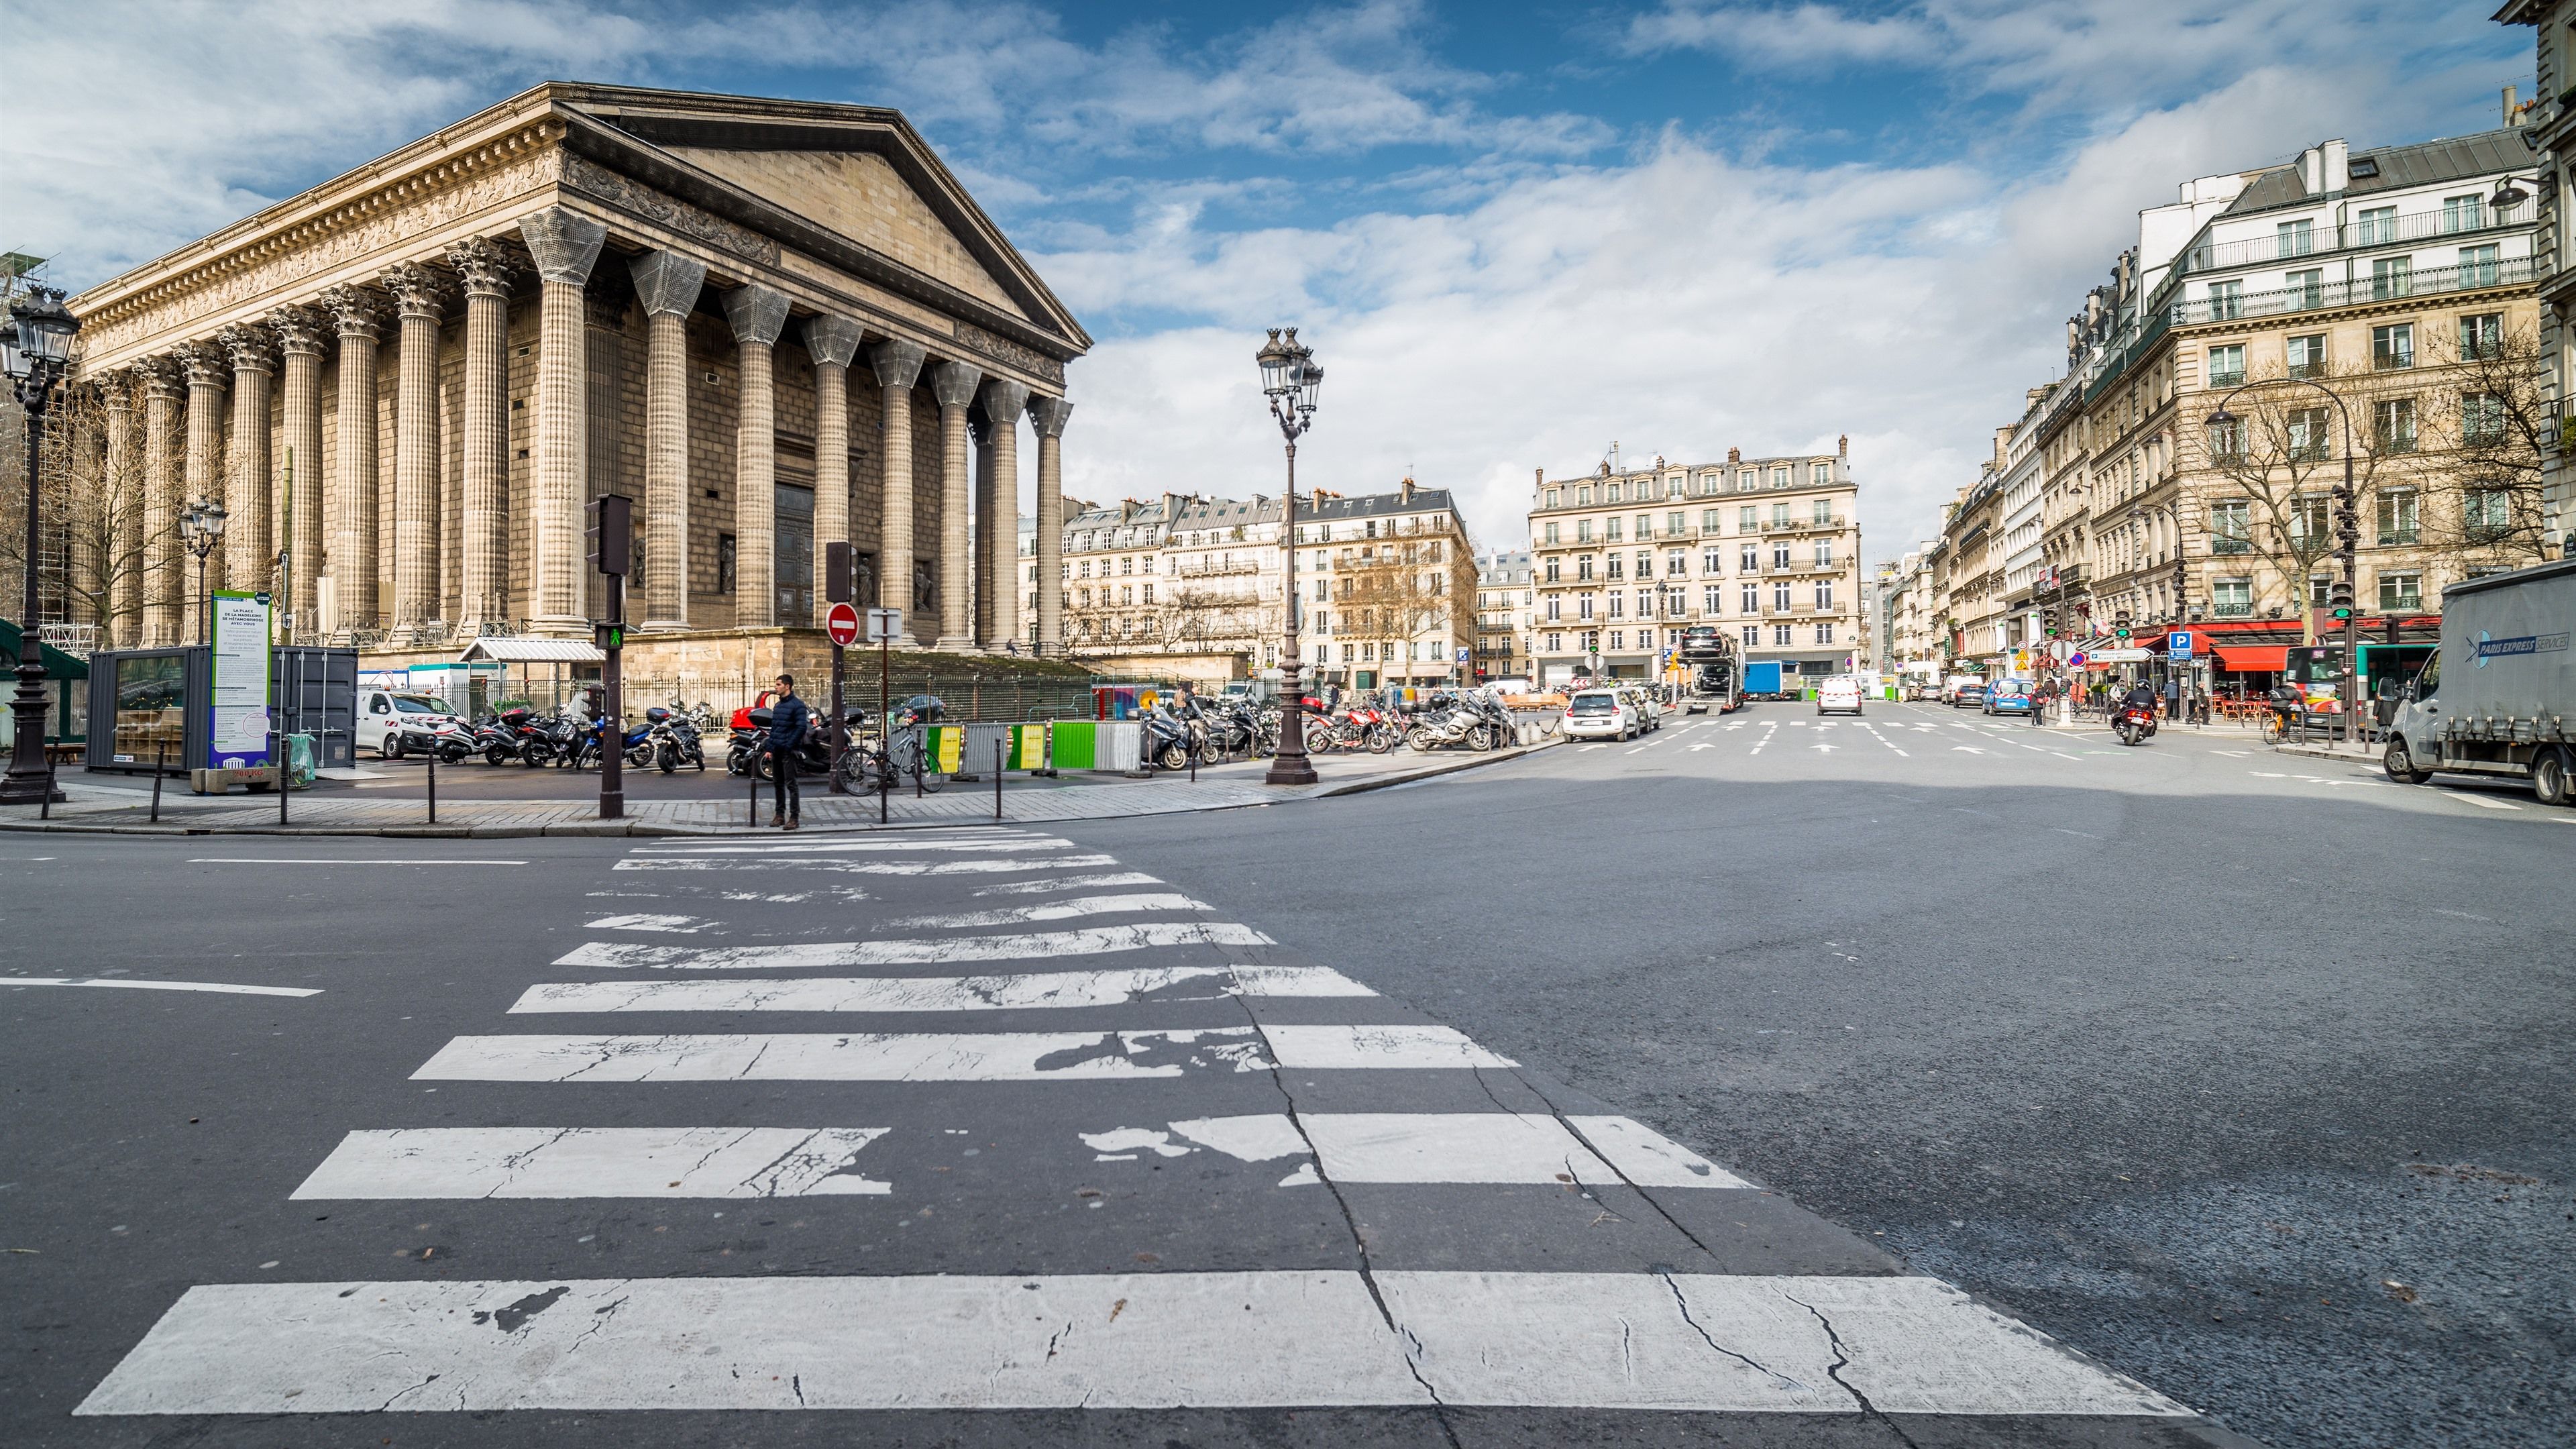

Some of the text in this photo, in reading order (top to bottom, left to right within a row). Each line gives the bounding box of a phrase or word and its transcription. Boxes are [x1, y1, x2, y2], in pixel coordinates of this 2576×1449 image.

[2177, 636, 2187, 647] P
[2480, 637, 2567, 655] PARIS EXPRESS SERVICES
[235, 769, 249, 777] 200
